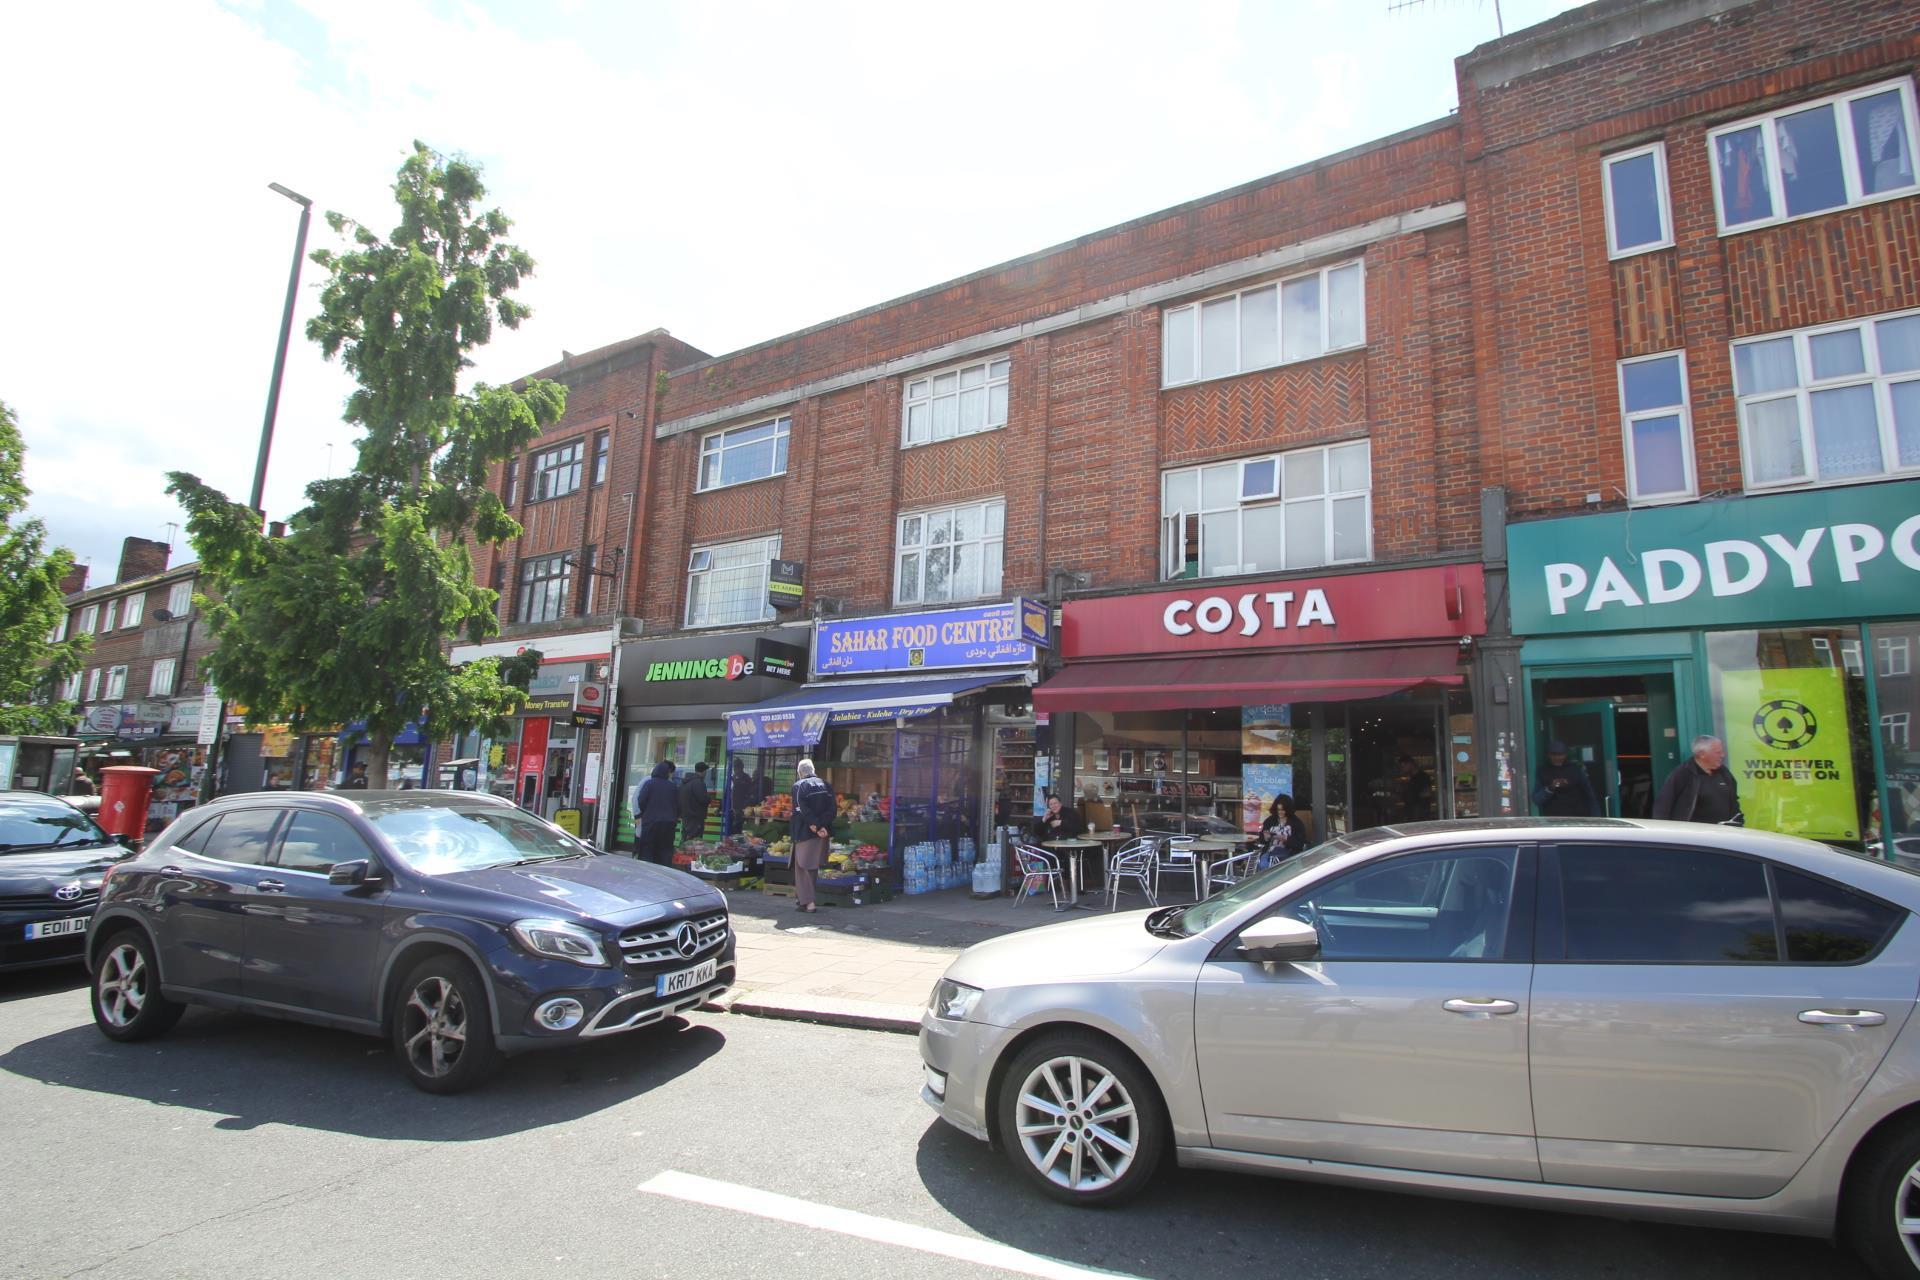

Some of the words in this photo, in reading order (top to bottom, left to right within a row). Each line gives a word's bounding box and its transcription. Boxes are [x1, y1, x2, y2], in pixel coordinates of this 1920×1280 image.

[1164, 589, 1336, 637] COSTA
[831, 628, 888, 654] SAHAR
[892, 624, 938, 649] FOOD
[941, 617, 1015, 645] CENTRE
[525, 701, 545, 710] Money
[544, 699, 570, 709] Transfer
[866, 709, 893, 719] Kulcha
[899, 708, 914, 716] Dry
[1745, 759, 1834, 769] WHATEVER
[1254, 775, 1287, 784] bubbles
[1743, 770, 1778, 780] YOU
[1782, 770, 1811, 780] BET
[1815, 770, 1840, 780] ON
[668, 970, 695, 992] KR17
[696, 963, 713, 985] KKA
